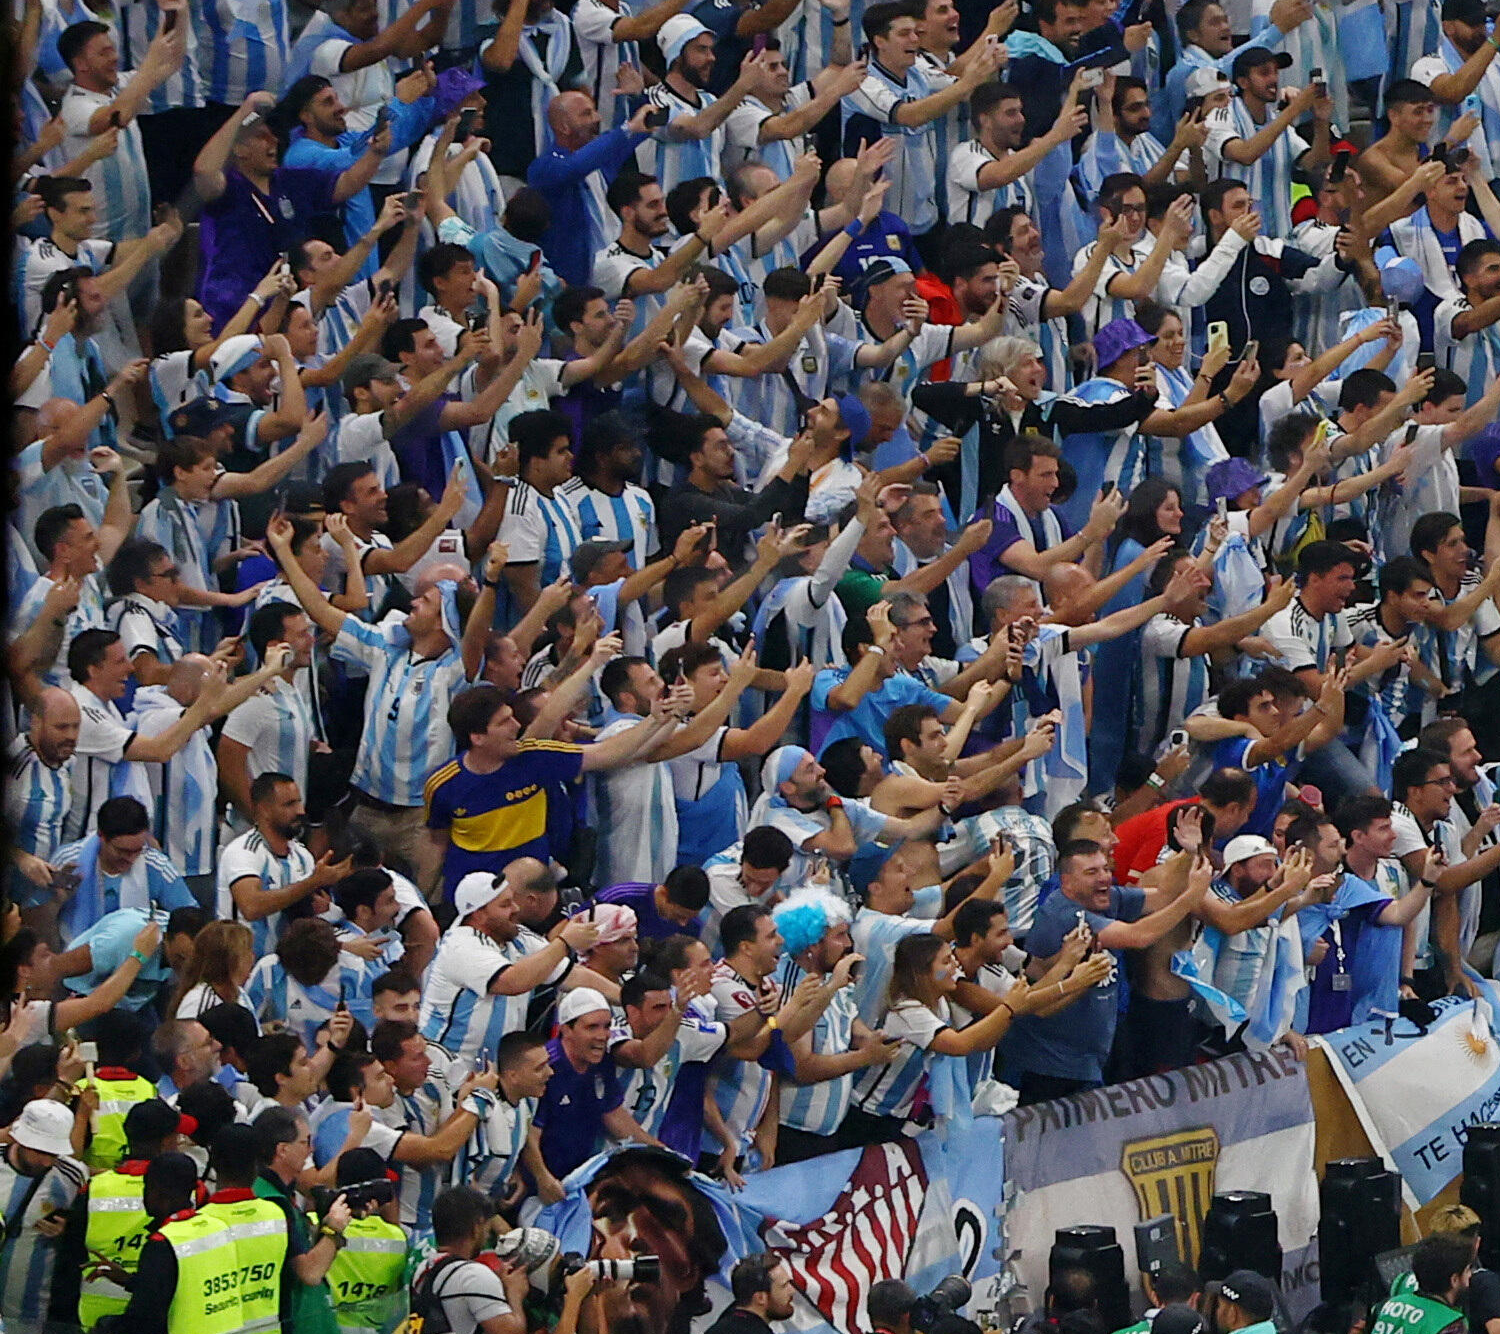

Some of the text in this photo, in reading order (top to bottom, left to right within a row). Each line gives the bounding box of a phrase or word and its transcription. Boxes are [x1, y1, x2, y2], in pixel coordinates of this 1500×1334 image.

[1345, 1041, 1374, 1068] EN
[1183, 1045, 1298, 1105] MITRE
[1132, 1151, 1167, 1171] CLUB
[1414, 1142, 1448, 1170] TE
[204, 1276, 238, 1297] 3853
